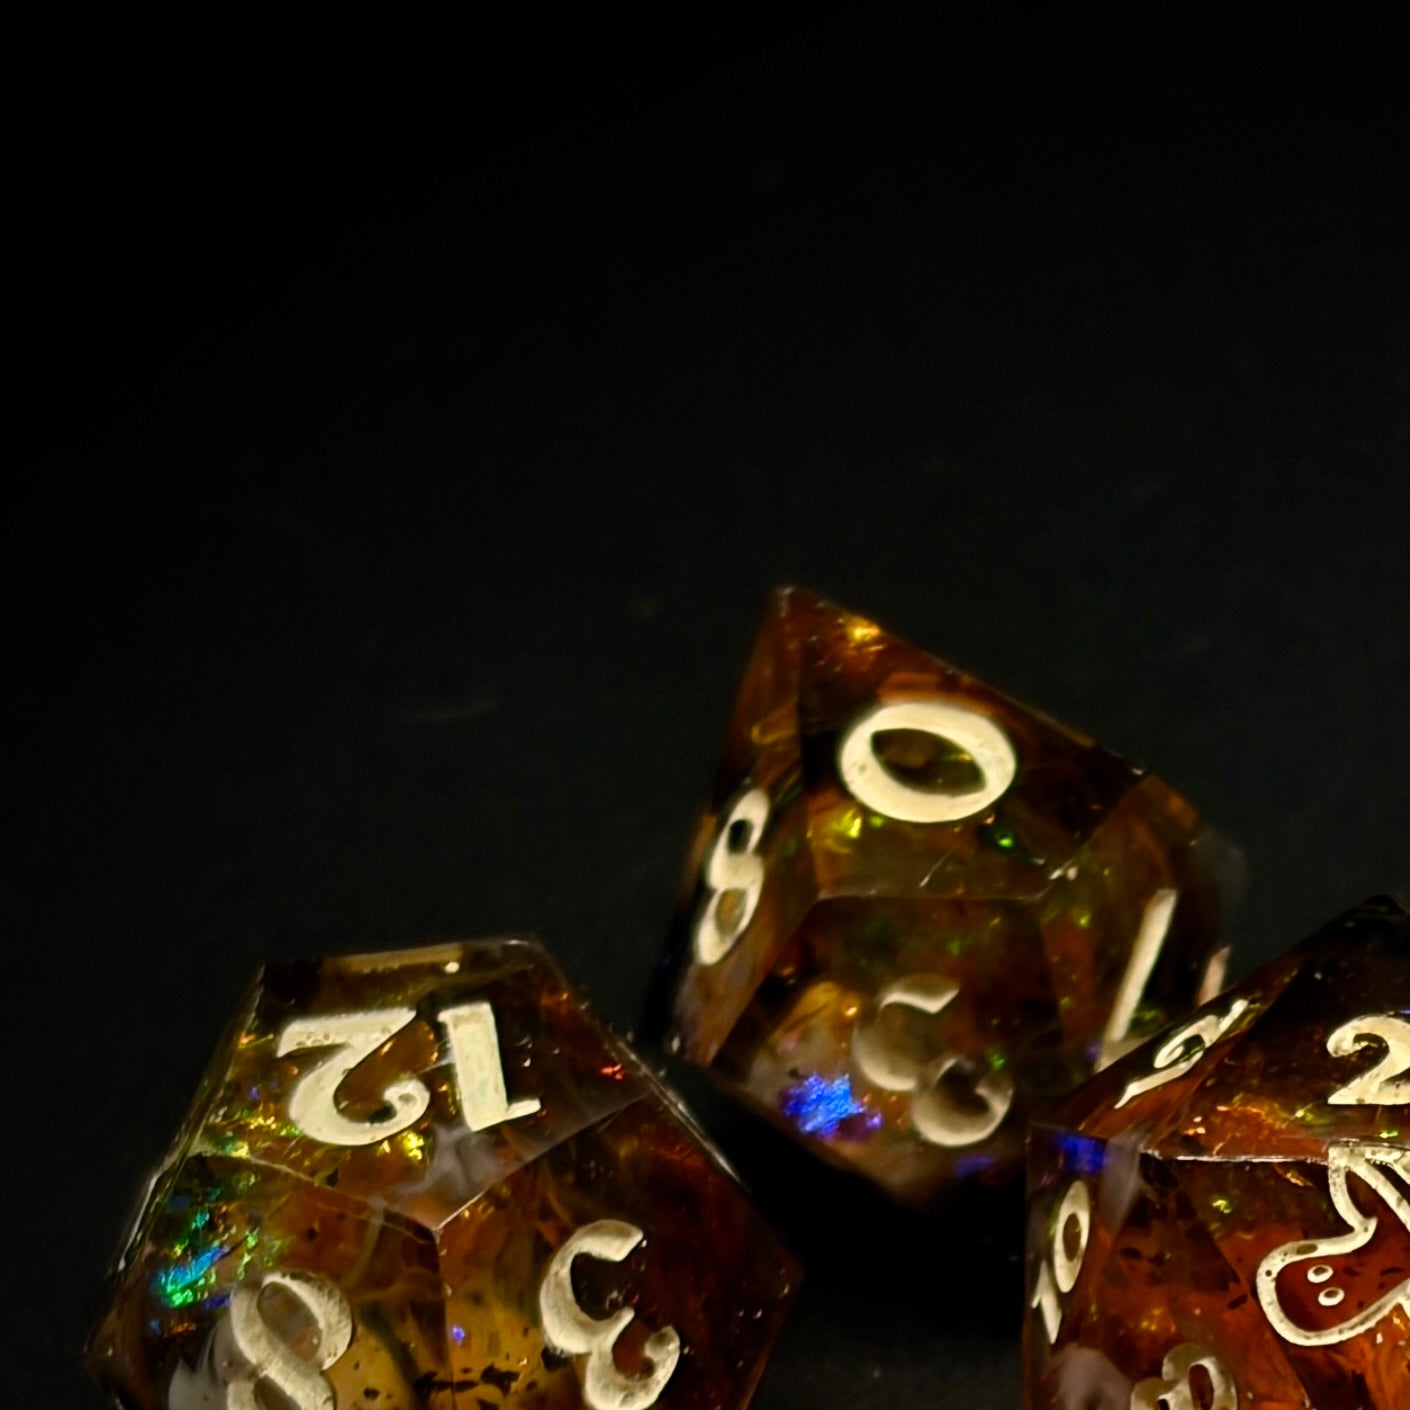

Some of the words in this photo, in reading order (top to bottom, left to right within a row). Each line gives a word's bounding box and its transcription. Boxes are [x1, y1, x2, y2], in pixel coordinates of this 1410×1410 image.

[838, 702, 1018, 824] 0
[696, 789, 771, 967] 8
[275, 1002, 542, 1147] 12
